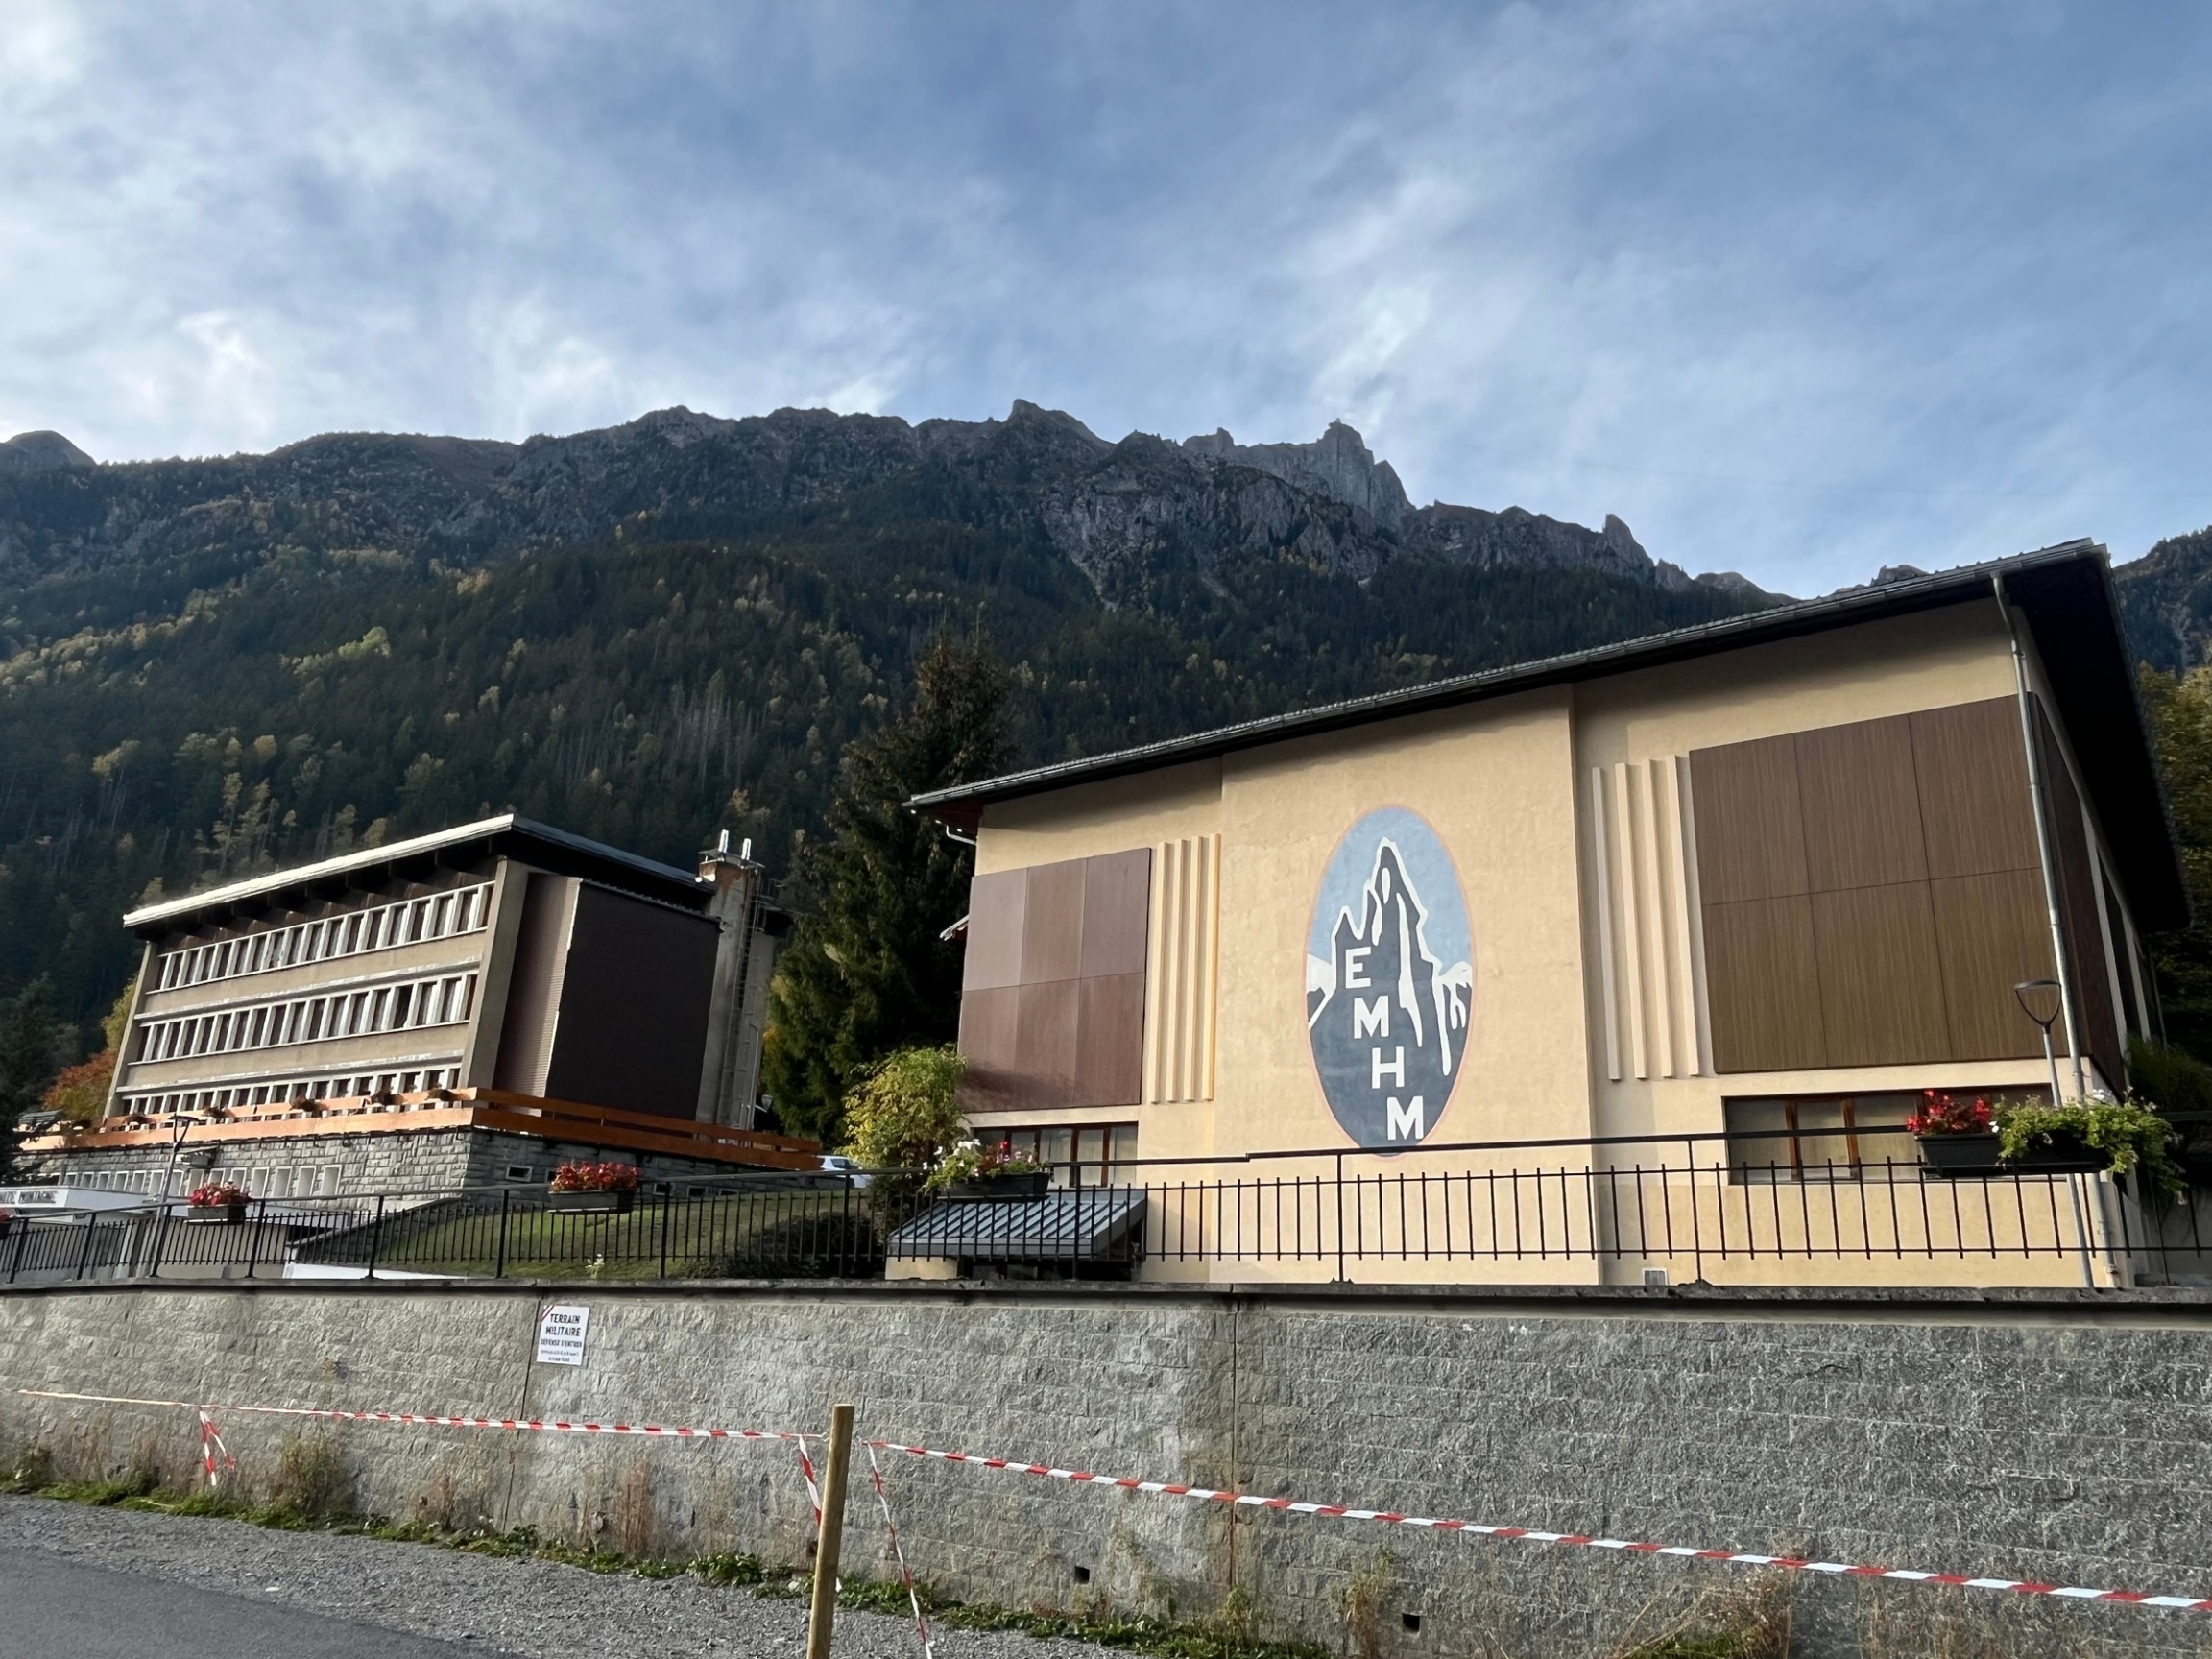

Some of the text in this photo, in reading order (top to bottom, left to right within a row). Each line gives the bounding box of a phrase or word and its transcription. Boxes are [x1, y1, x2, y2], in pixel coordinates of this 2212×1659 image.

[1345, 946, 1424, 1141] EMHM
[550, 1313, 581, 1324] TERRAIN
[545, 1326, 581, 1336] MILITAIRE
